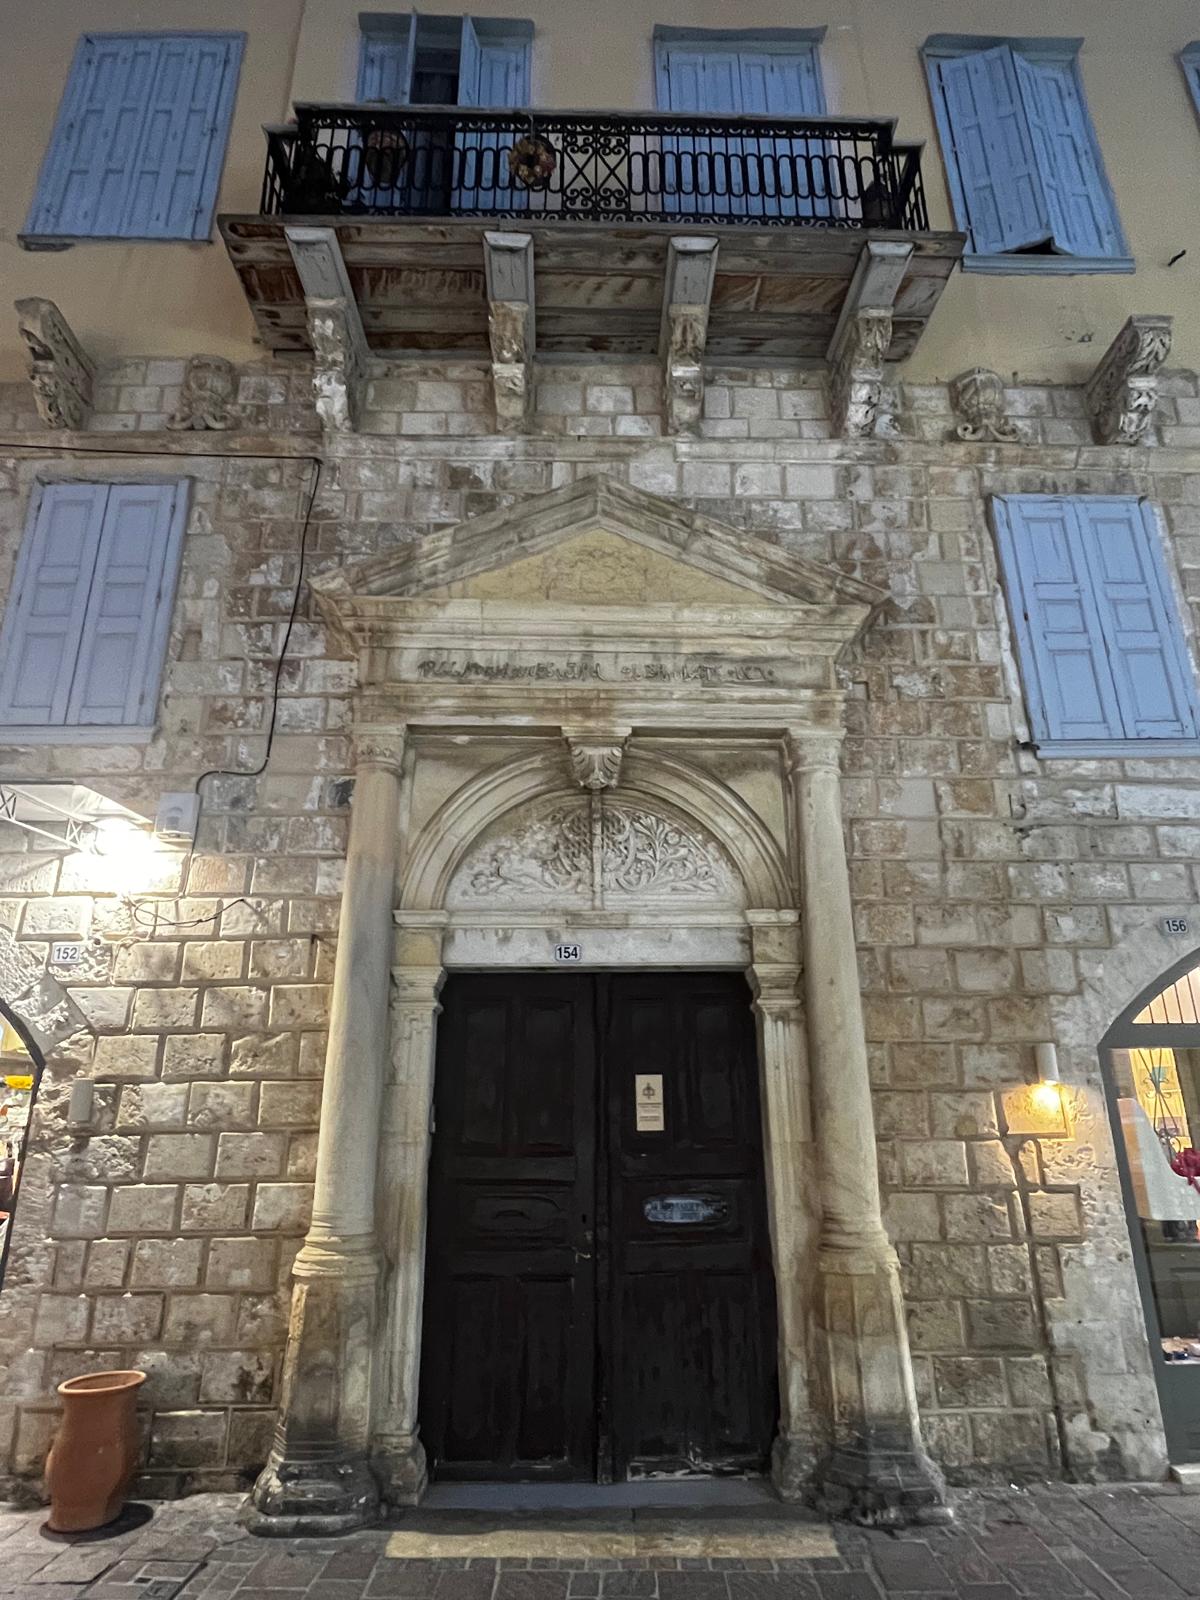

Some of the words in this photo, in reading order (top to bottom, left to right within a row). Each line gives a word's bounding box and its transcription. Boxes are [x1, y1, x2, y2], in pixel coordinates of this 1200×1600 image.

[1166, 919, 1187, 932] 156
[55, 947, 78, 960] 152
[557, 946, 578, 959] 154
